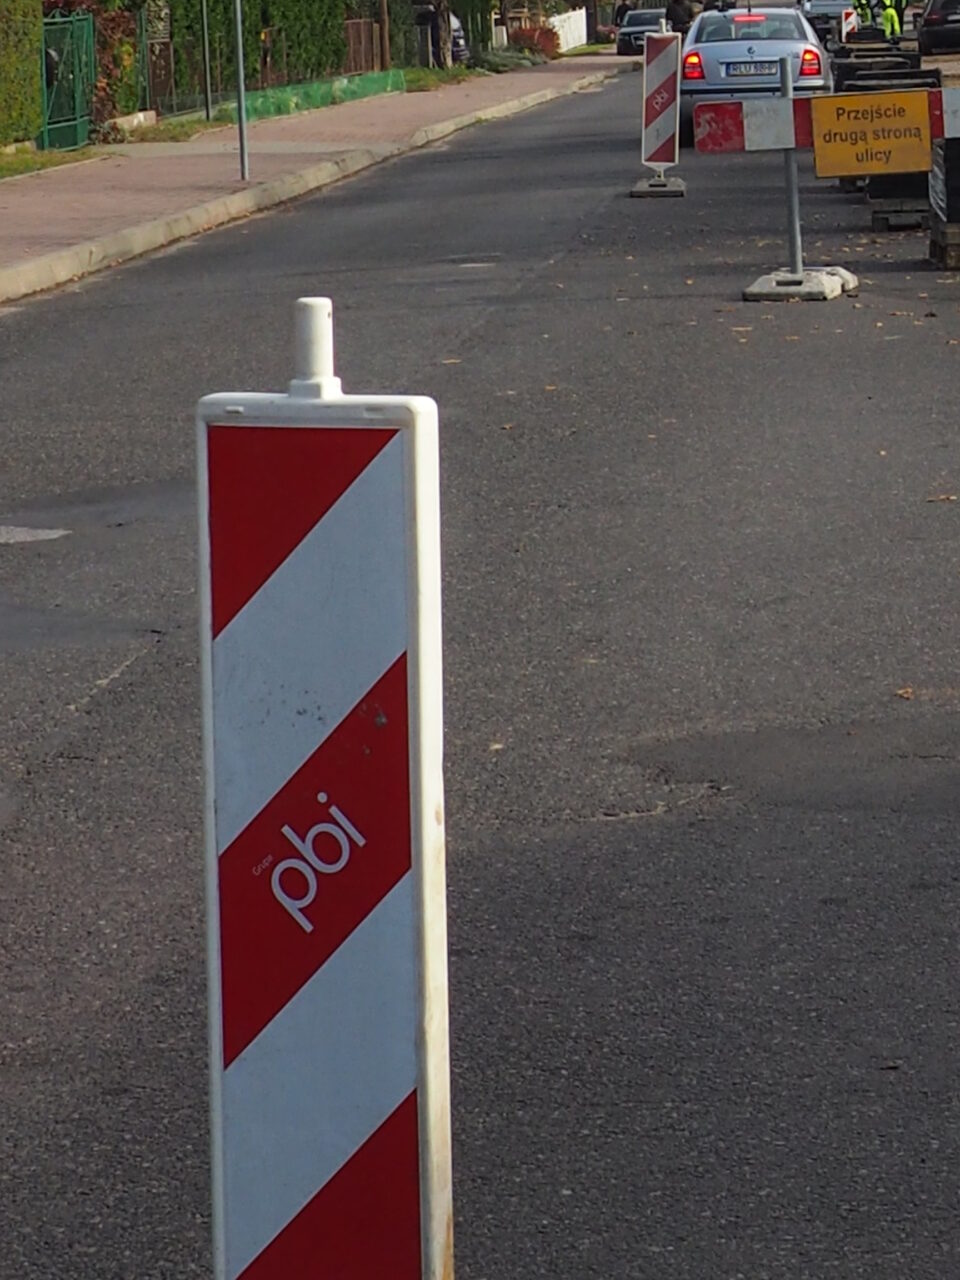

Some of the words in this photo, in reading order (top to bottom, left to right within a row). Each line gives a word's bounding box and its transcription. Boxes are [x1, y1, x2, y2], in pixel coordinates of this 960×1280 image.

[836, 103, 906, 123] Przejście
[823, 128, 869, 145] drugą
[872, 125, 923, 142] stroną
[855, 148, 892, 164] ulicy
[271, 791, 367, 934] pbi
